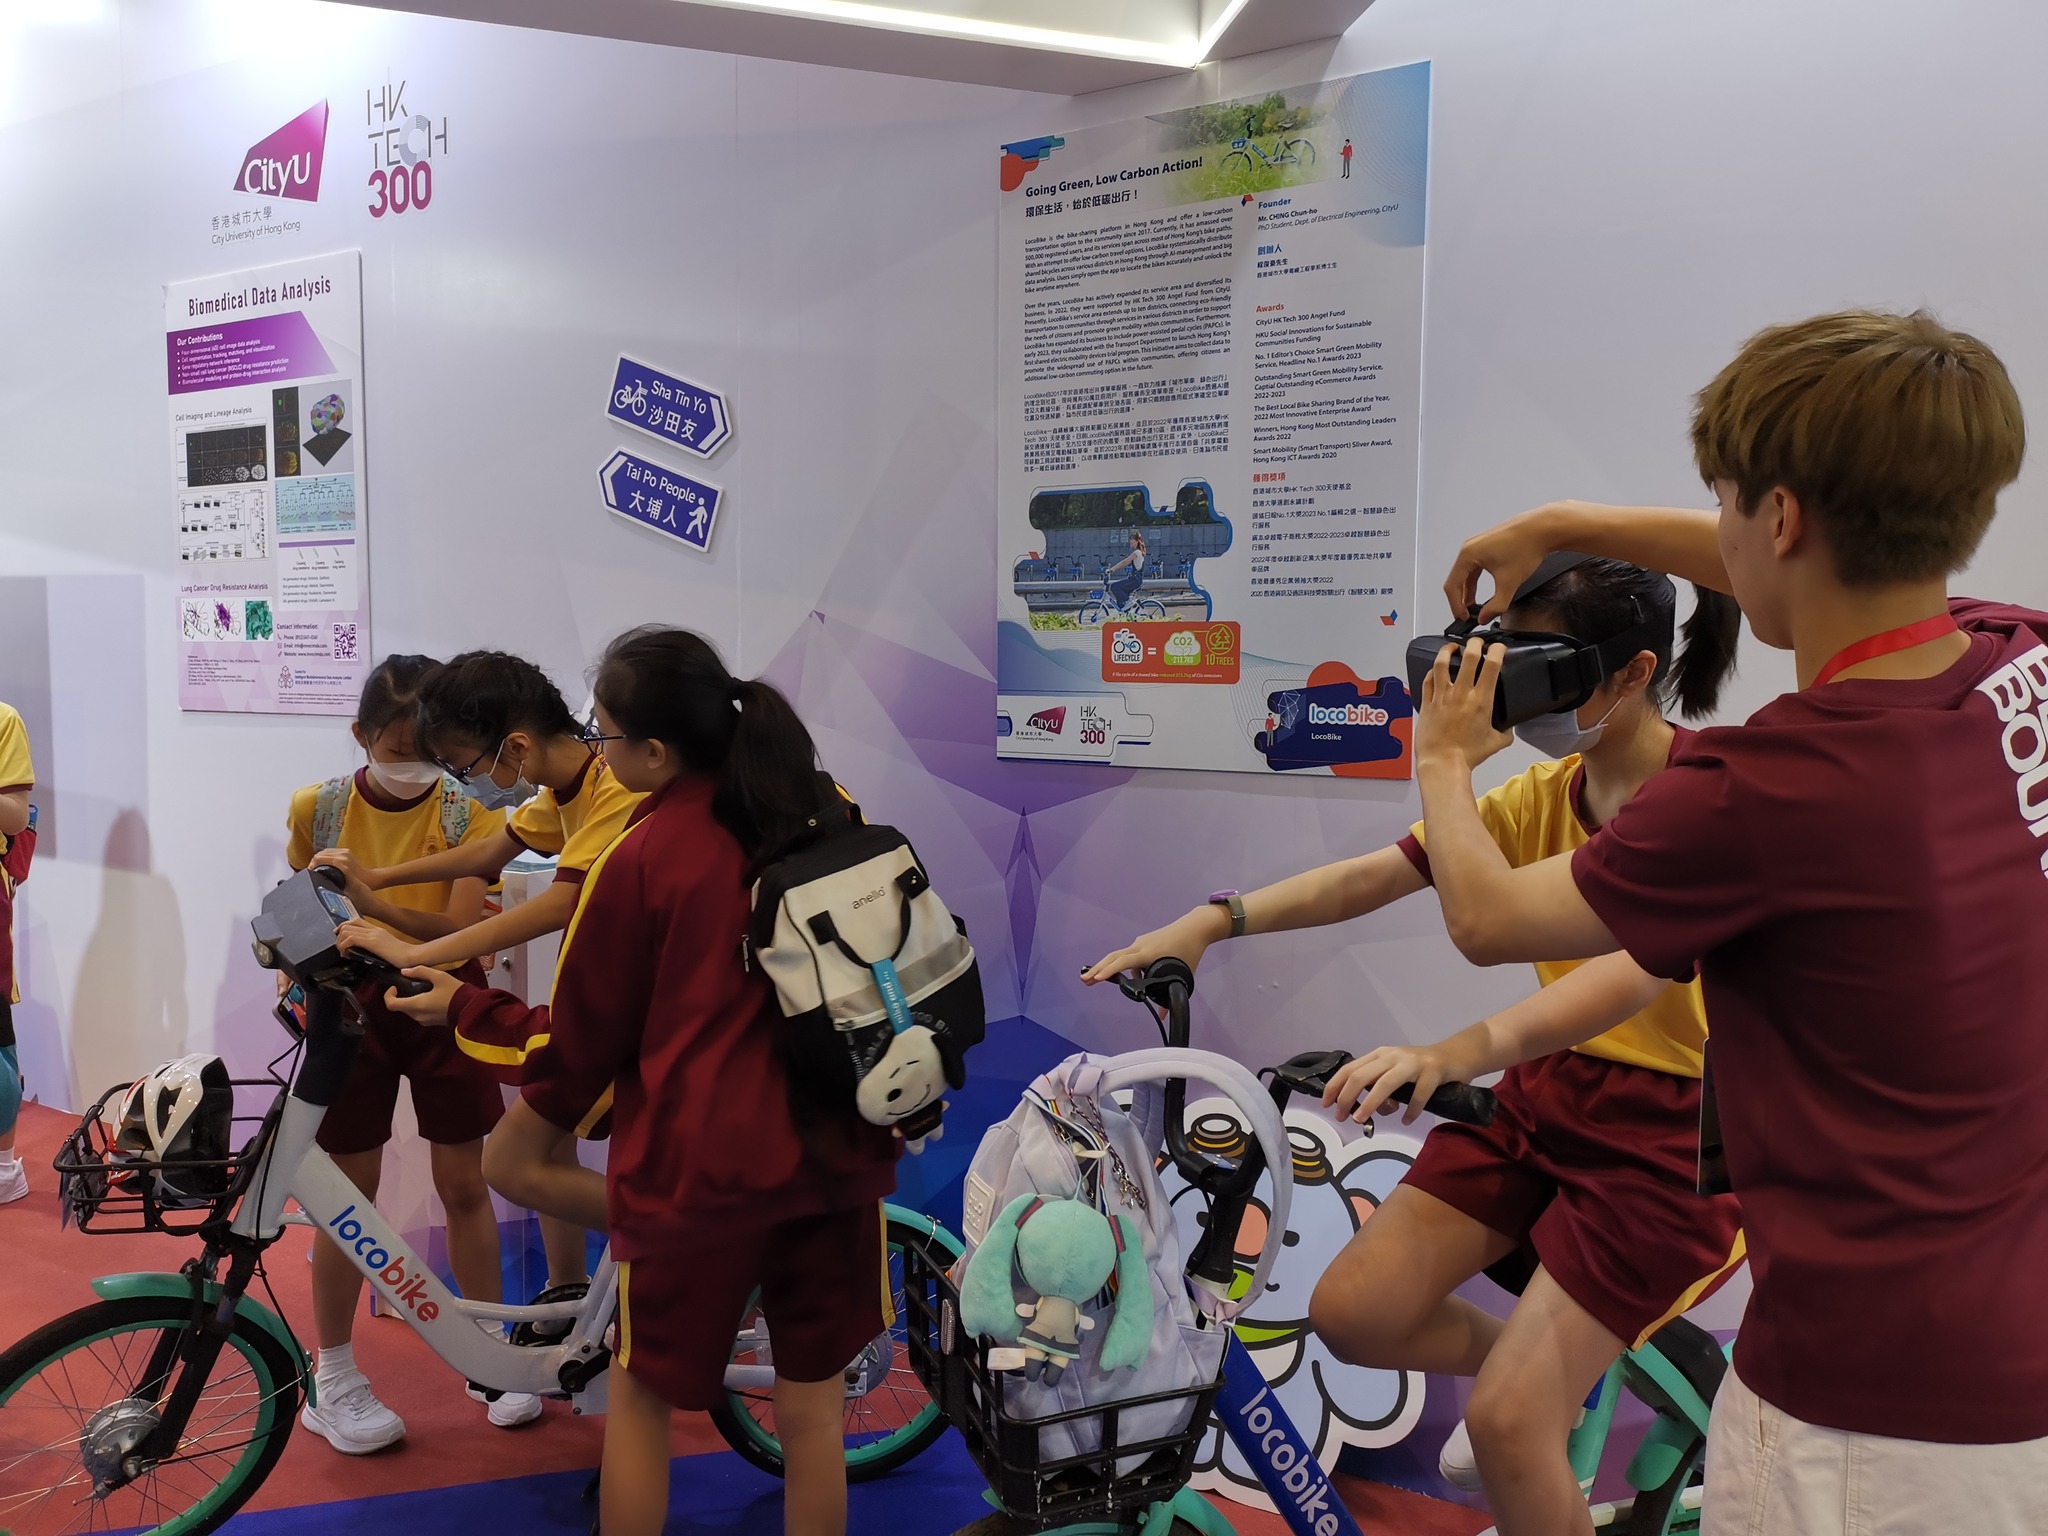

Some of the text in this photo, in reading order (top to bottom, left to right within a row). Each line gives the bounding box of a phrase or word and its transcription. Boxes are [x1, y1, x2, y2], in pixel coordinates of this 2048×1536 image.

[366, 80, 408, 126] HK
[368, 114, 447, 169] TECH
[245, 152, 310, 197] CityU
[1026, 156, 1202, 197] Going Green, Low Carbon Action!
[368, 160, 432, 218] 300
[1026, 190, 1137, 217] 環保生活，始於低碳出行！
[1258, 199, 1291, 209] Founder
[212, 206, 272, 230] 香港城市大學
[1269, 212, 1289, 221] CHING
[1290, 208, 1318, 217] Chun-ho
[1317, 212, 1344, 222] Electrical
[1382, 204, 1399, 212] CityU
[212, 221, 301, 246] City University of Hong Kong
[1025, 237, 1046, 245] LocoBike
[1067, 230, 1097, 238] bike-sharing
[1100, 226, 1122, 235] platform
[189, 275, 330, 316] Biomedical Data Analysis
[1256, 303, 1284, 312] Awards
[1256, 318, 1272, 326] CityU
[1310, 312, 1328, 320] Angel
[1270, 329, 1288, 337] Social
[1289, 326, 1324, 335] Innovations
[1335, 320, 1372, 330] Sustainable
[177, 333, 223, 346] Our Contributions
[1255, 335, 1321, 347] Communities Funding
[1356, 342, 1382, 350] Mobility
[1322, 354, 1345, 362] Awards
[1346, 352, 1361, 360] 2023
[1254, 373, 1292, 382] Outstanding
[1276, 380, 1314, 388] Outstanding
[1315, 377, 1352, 385] eCommerce
[1353, 373, 1376, 381] Awards
[651, 380, 707, 414] Sha Tin Yo
[1254, 391, 1285, 399] 2022-2023
[1280, 402, 1296, 410] Local
[1336, 397, 1355, 405] Brand
[185, 413, 203, 421] Imaging
[1254, 413, 1269, 421] 2022
[1286, 410, 1318, 418] Innovative
[1318, 407, 1350, 415] Enterprise
[647, 404, 698, 442] 沙田友
[1331, 419, 1370, 427] Outstanding
[1253, 434, 1275, 442] Awards
[1319, 442, 1351, 450] Transport)
[626, 462, 696, 504] Tai Po People
[628, 490, 677, 528] 大埔人
[210, 584, 221, 592] Drug
[1173, 637, 1192, 645] CO2
[1114, 654, 1140, 662] LIFECYCLE
[1205, 654, 1235, 665] 10 TREES
[1081, 706, 1097, 717] HK
[1310, 704, 1387, 725] locobike
[1031, 717, 1058, 731] CityU
[1081, 717, 1111, 731] TECH
[1080, 730, 1105, 744] 300
[852, 889, 886, 909] anello
[329, 1205, 439, 1322] locobike
[1239, 1387, 1339, 1536] locobike
